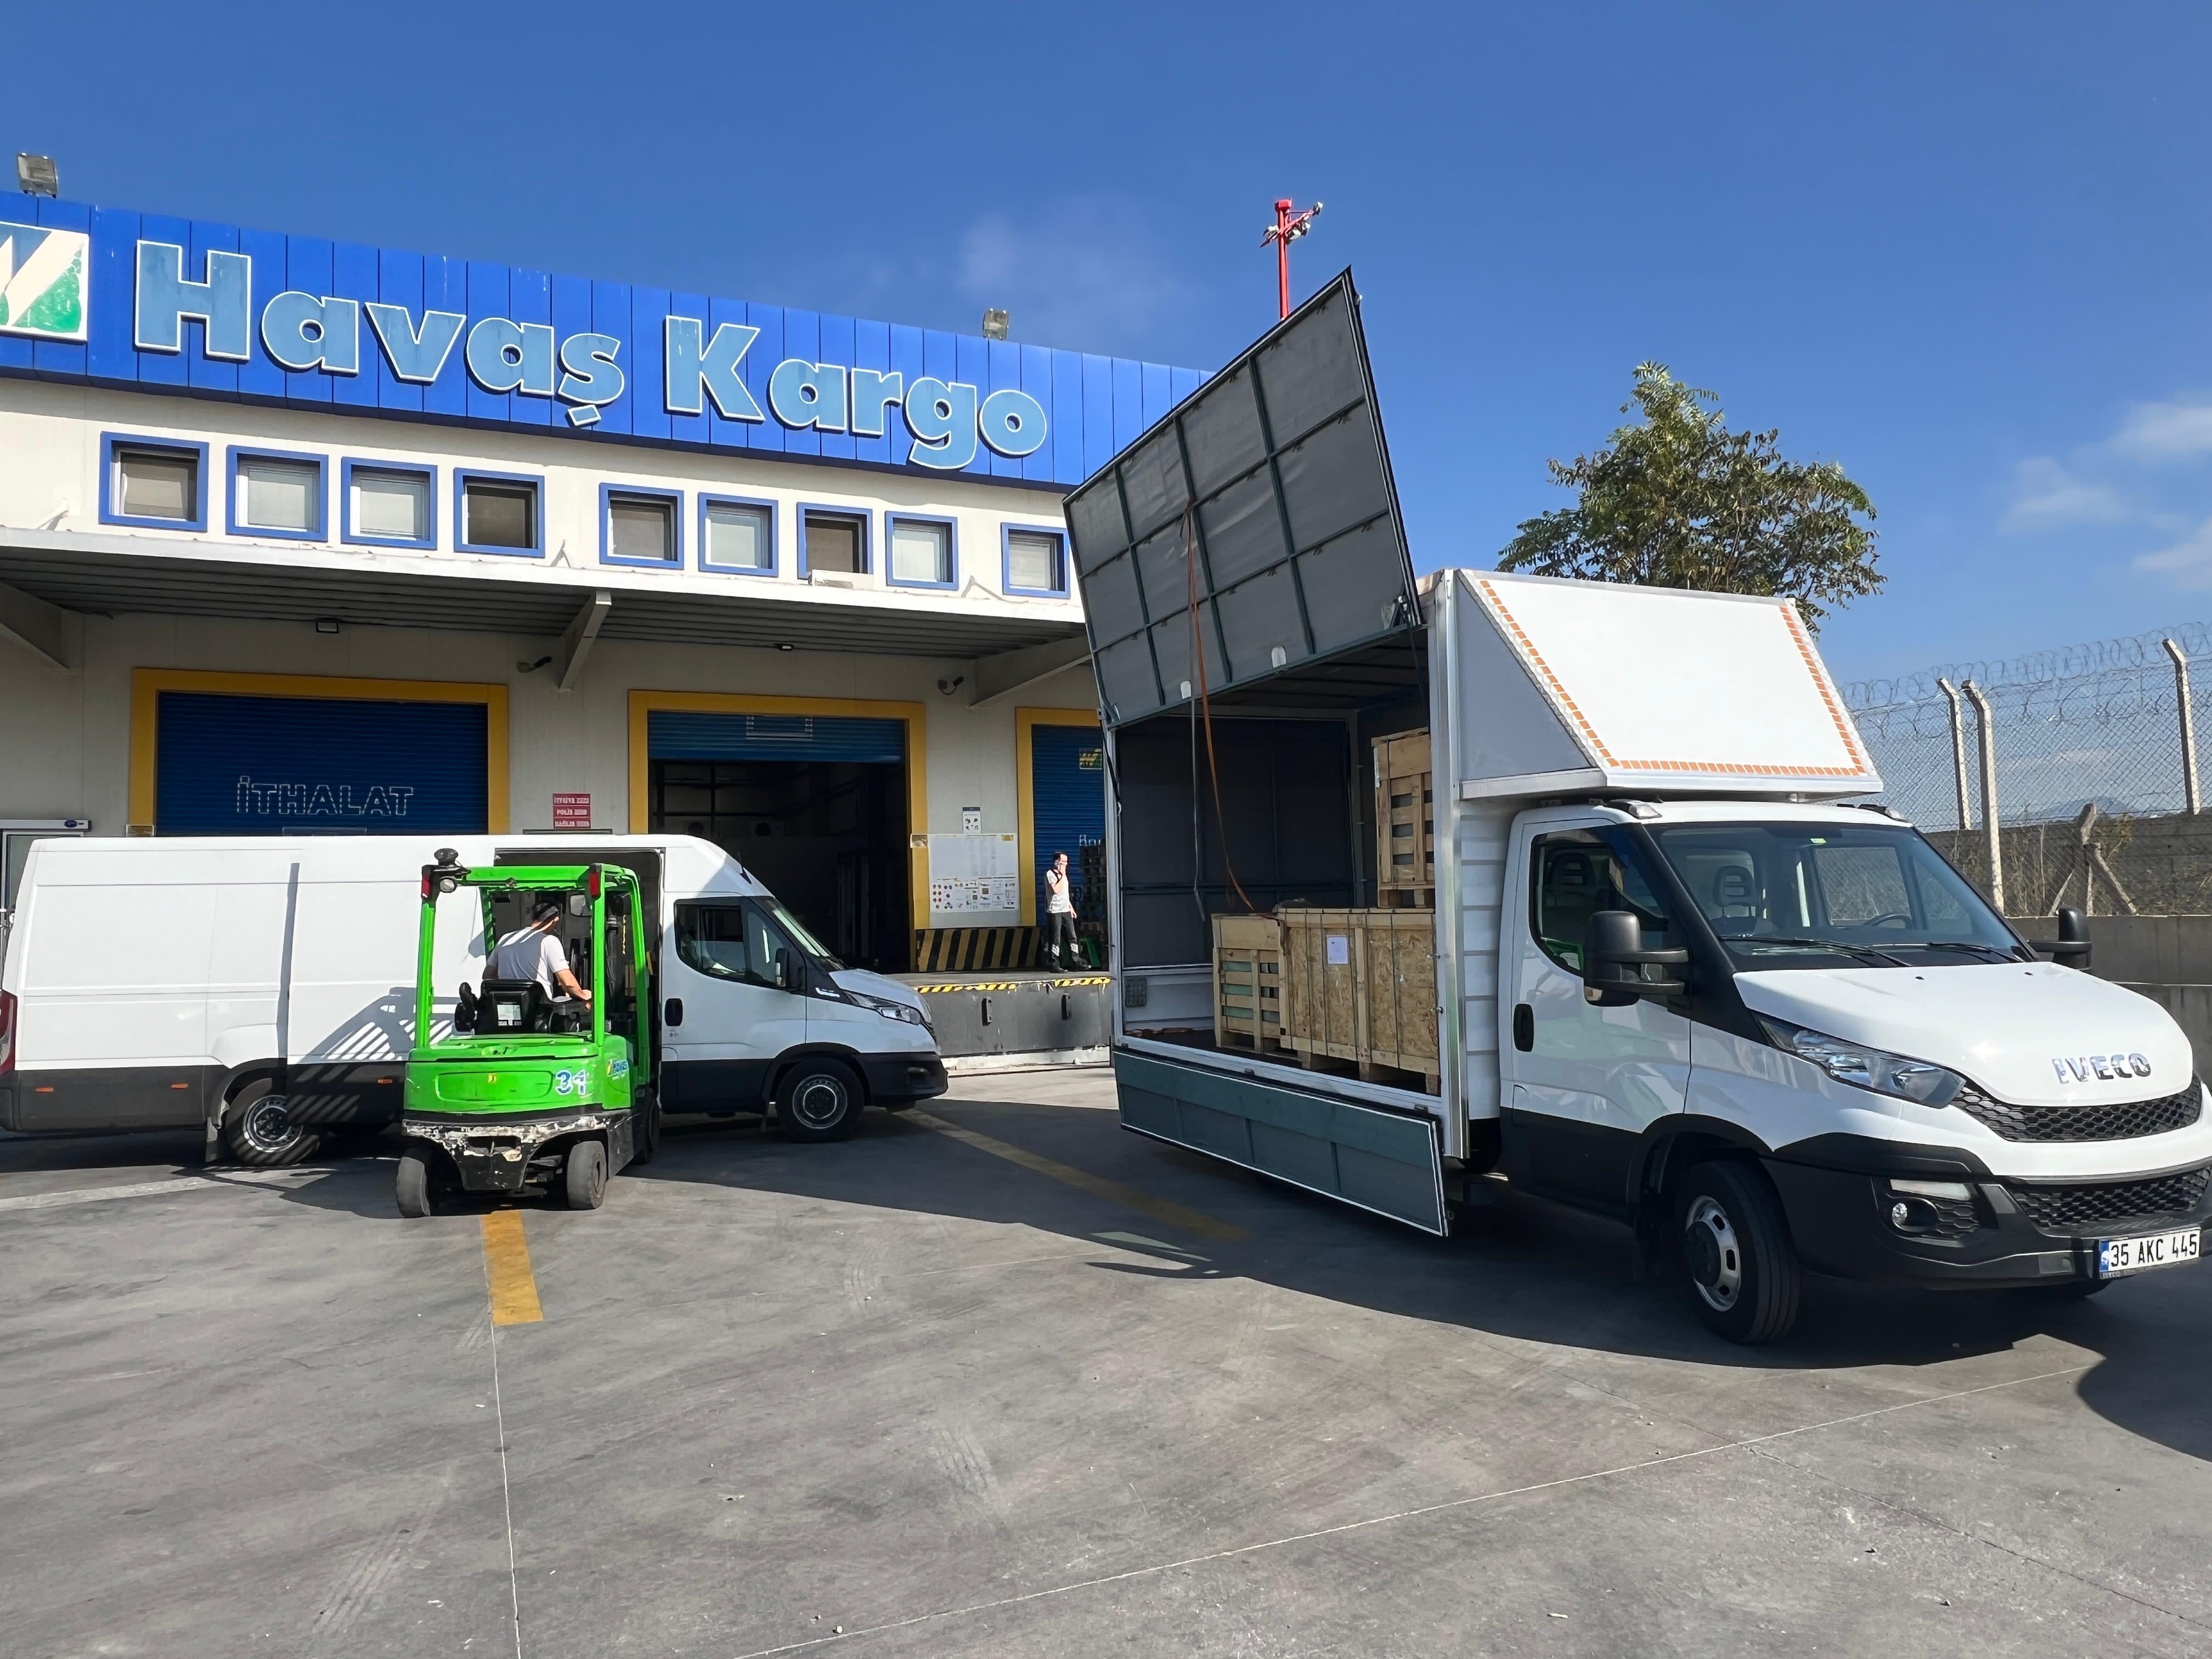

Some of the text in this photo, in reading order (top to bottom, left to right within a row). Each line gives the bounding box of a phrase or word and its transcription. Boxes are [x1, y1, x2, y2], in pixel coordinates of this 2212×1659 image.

[135, 239, 1047, 470] Havaş Kargo
[236, 775, 414, 816] İTHALAT
[2052, 1053, 2151, 1084] IVECO
[2111, 1234, 2197, 1267] 35 AKC 445
